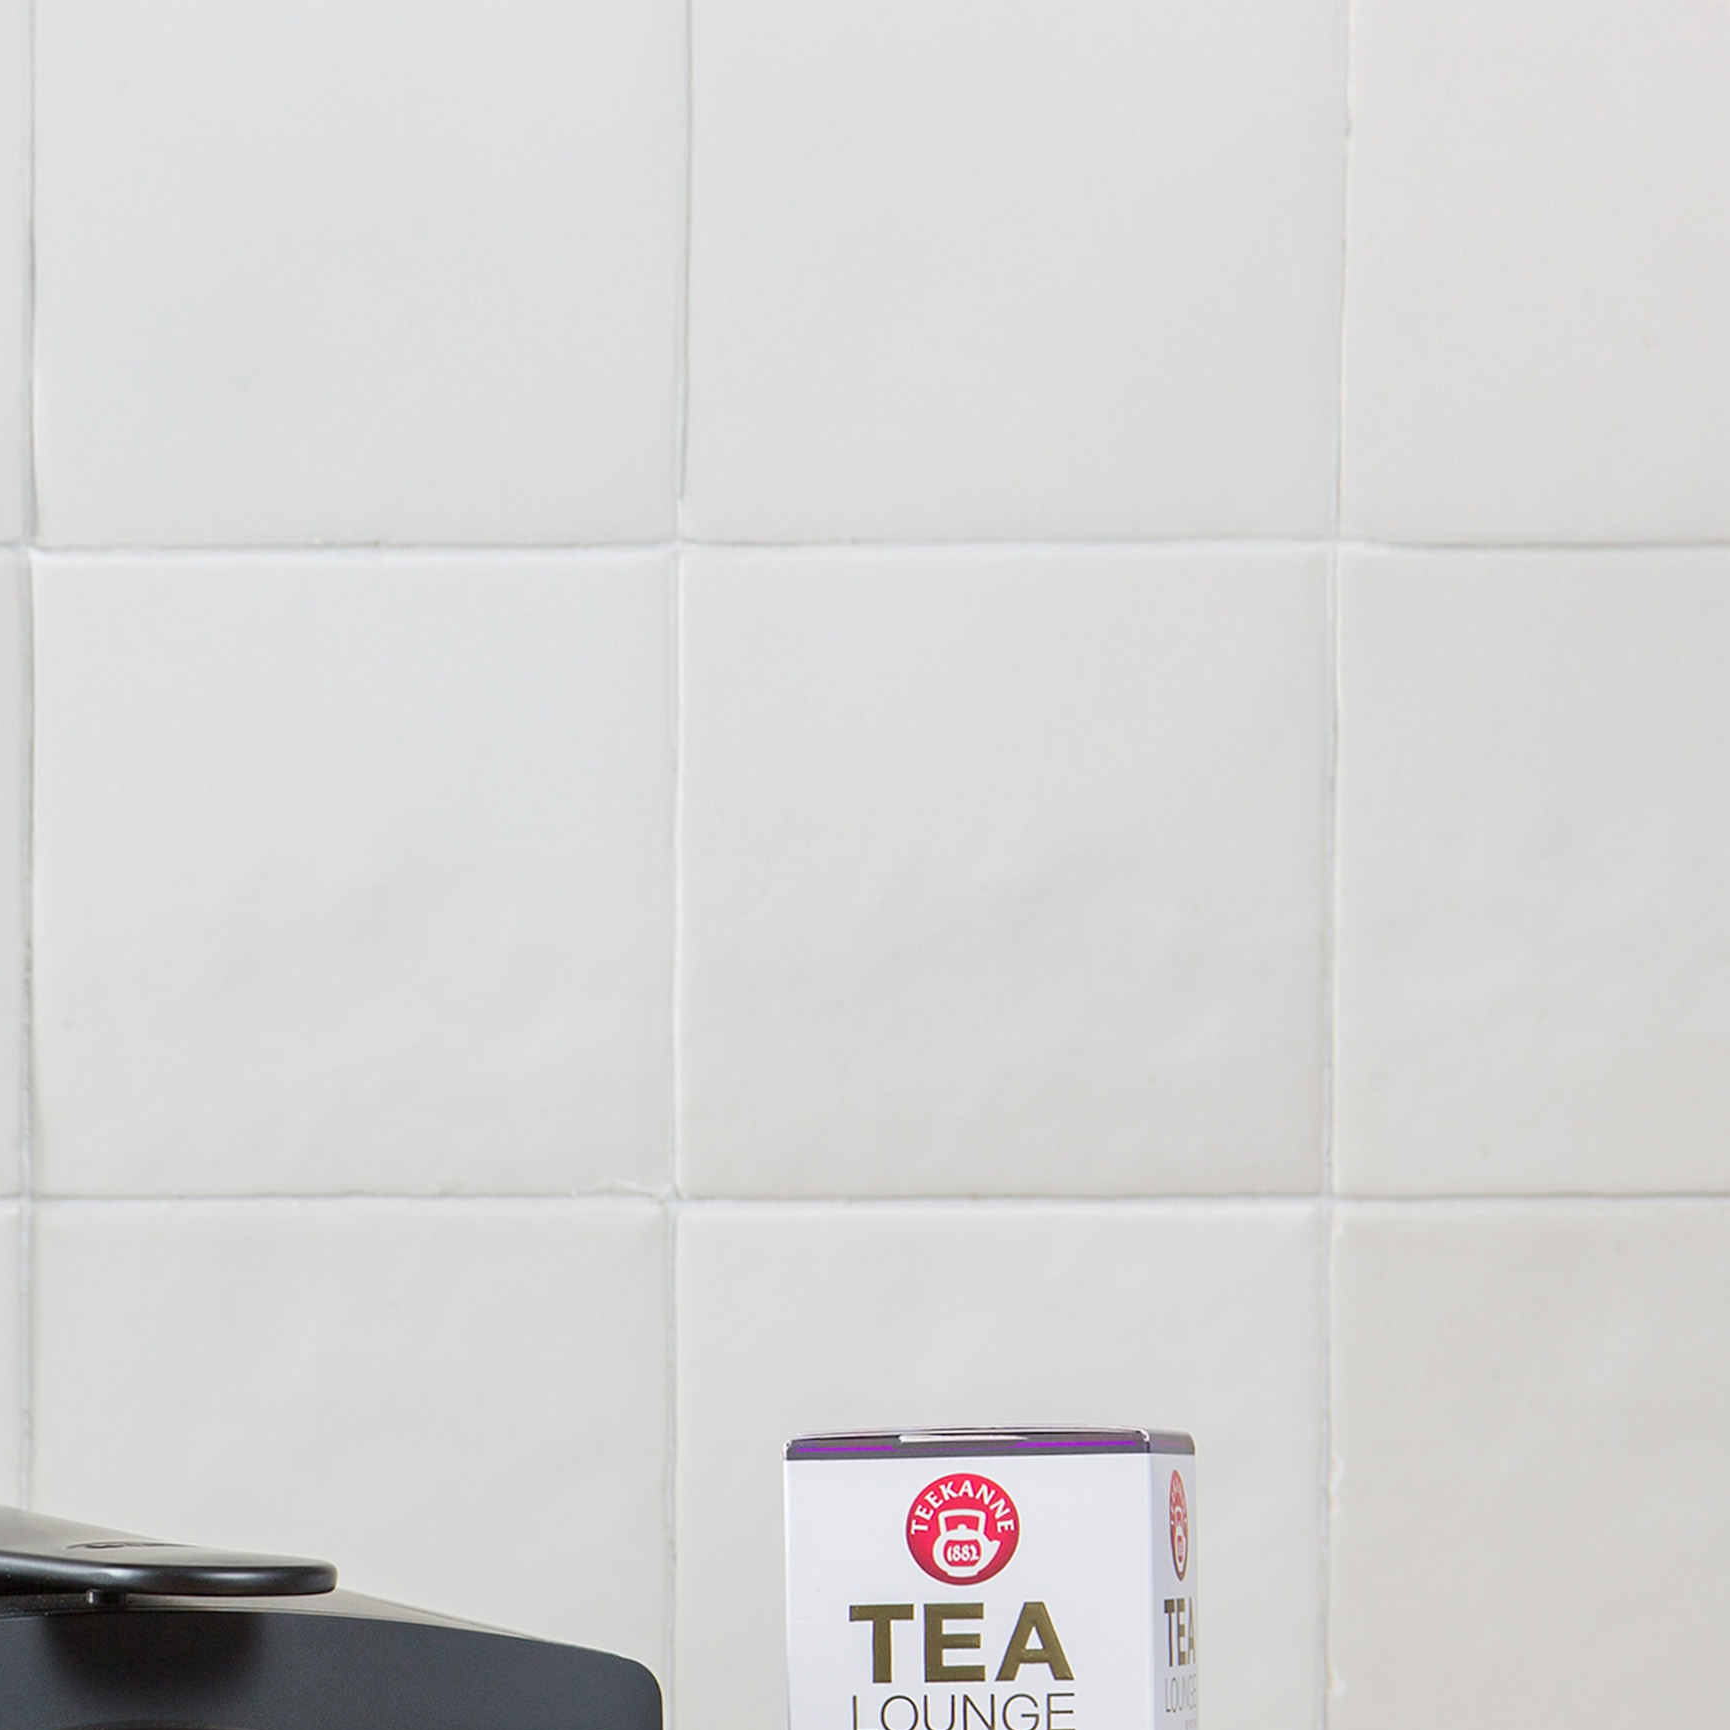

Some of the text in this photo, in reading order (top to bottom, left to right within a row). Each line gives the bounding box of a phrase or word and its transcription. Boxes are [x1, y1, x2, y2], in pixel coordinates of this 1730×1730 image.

[909, 1480, 1017, 1535] TEEKANNE
[946, 1544, 980, 1562] 1882
[849, 1602, 1074, 1683] TEA
